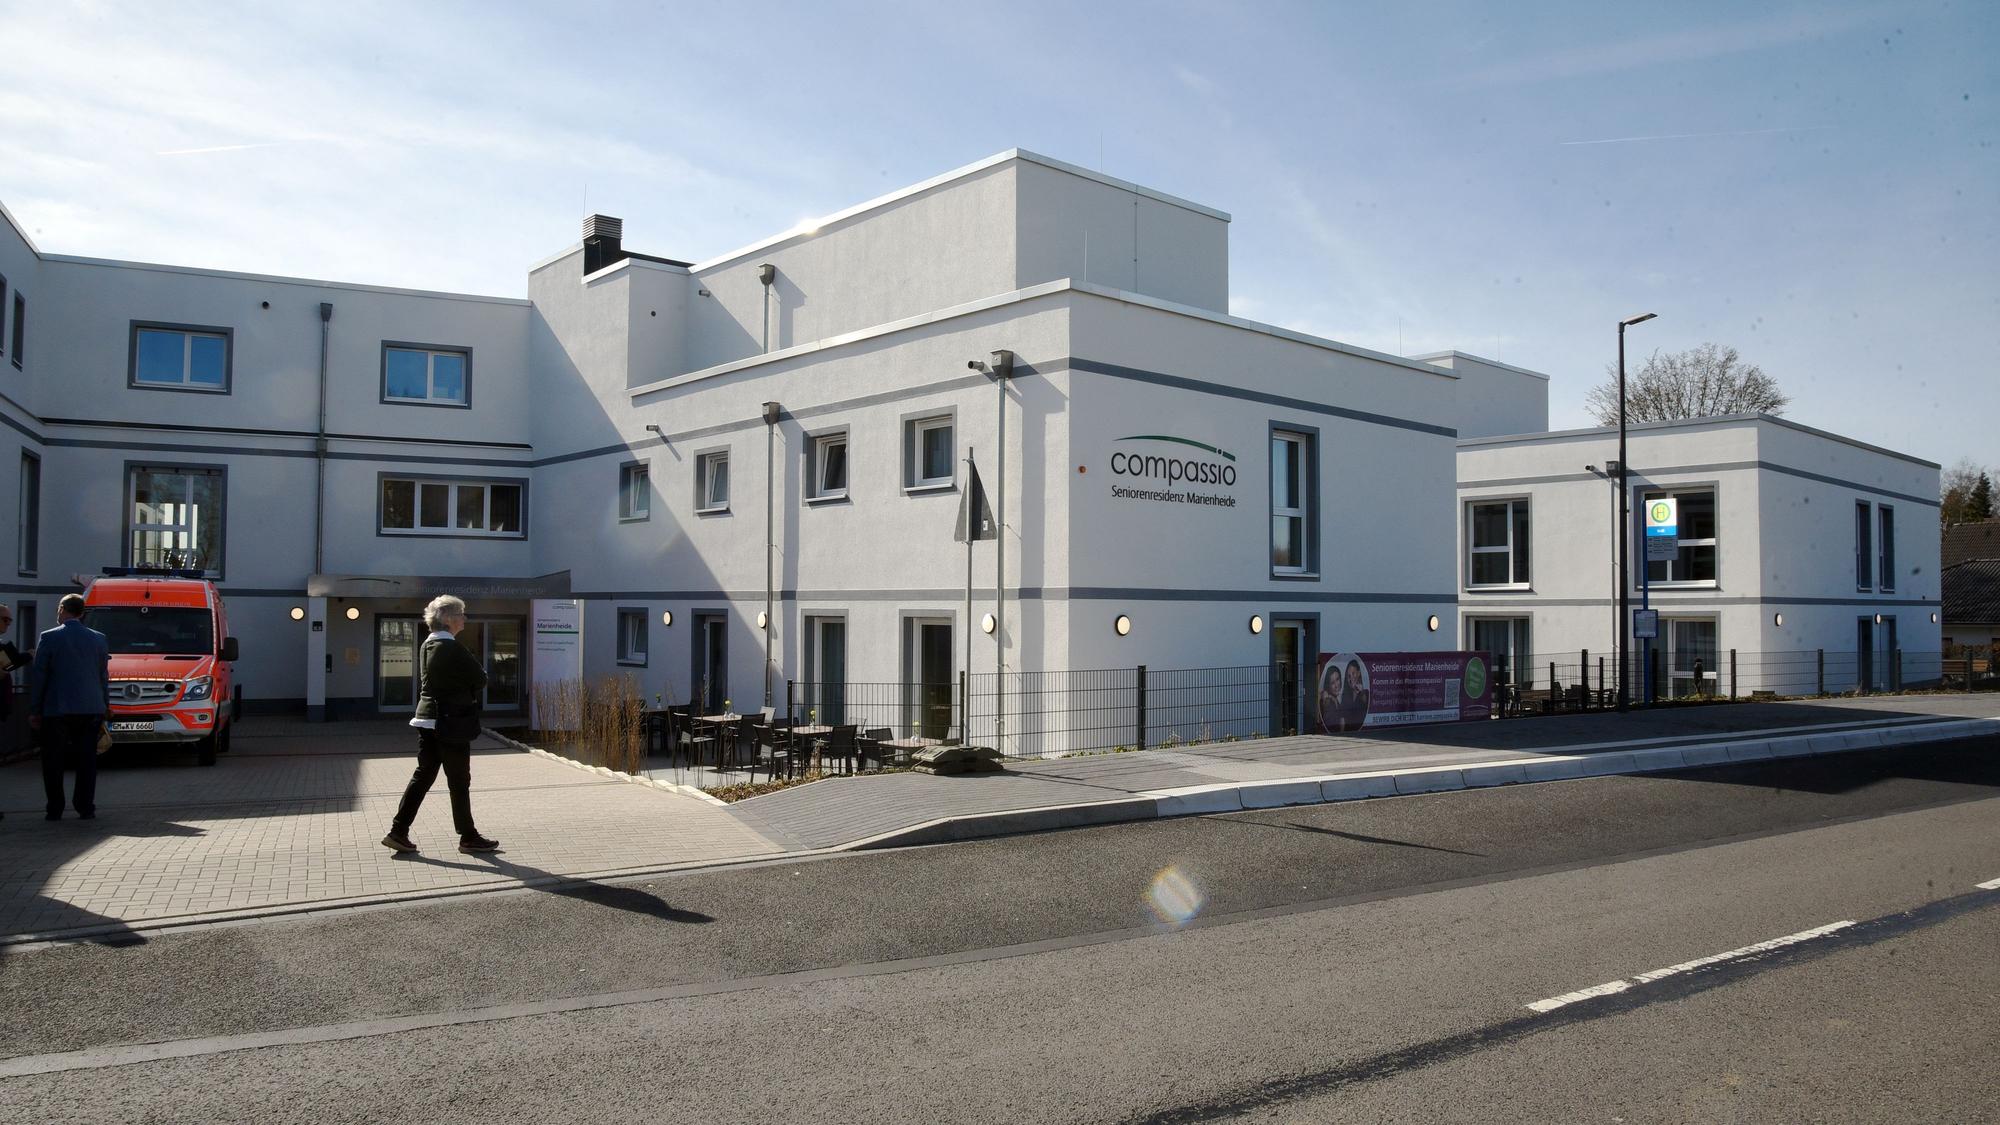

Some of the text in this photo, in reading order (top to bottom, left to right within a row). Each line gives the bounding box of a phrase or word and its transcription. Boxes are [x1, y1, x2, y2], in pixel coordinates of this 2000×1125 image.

[1111, 452, 1236, 486] compassio
[1111, 485, 1236, 507] Seniorenresidenz Marienheide
[1372, 662, 1459, 672] Seniorenresidenz Marienheide
